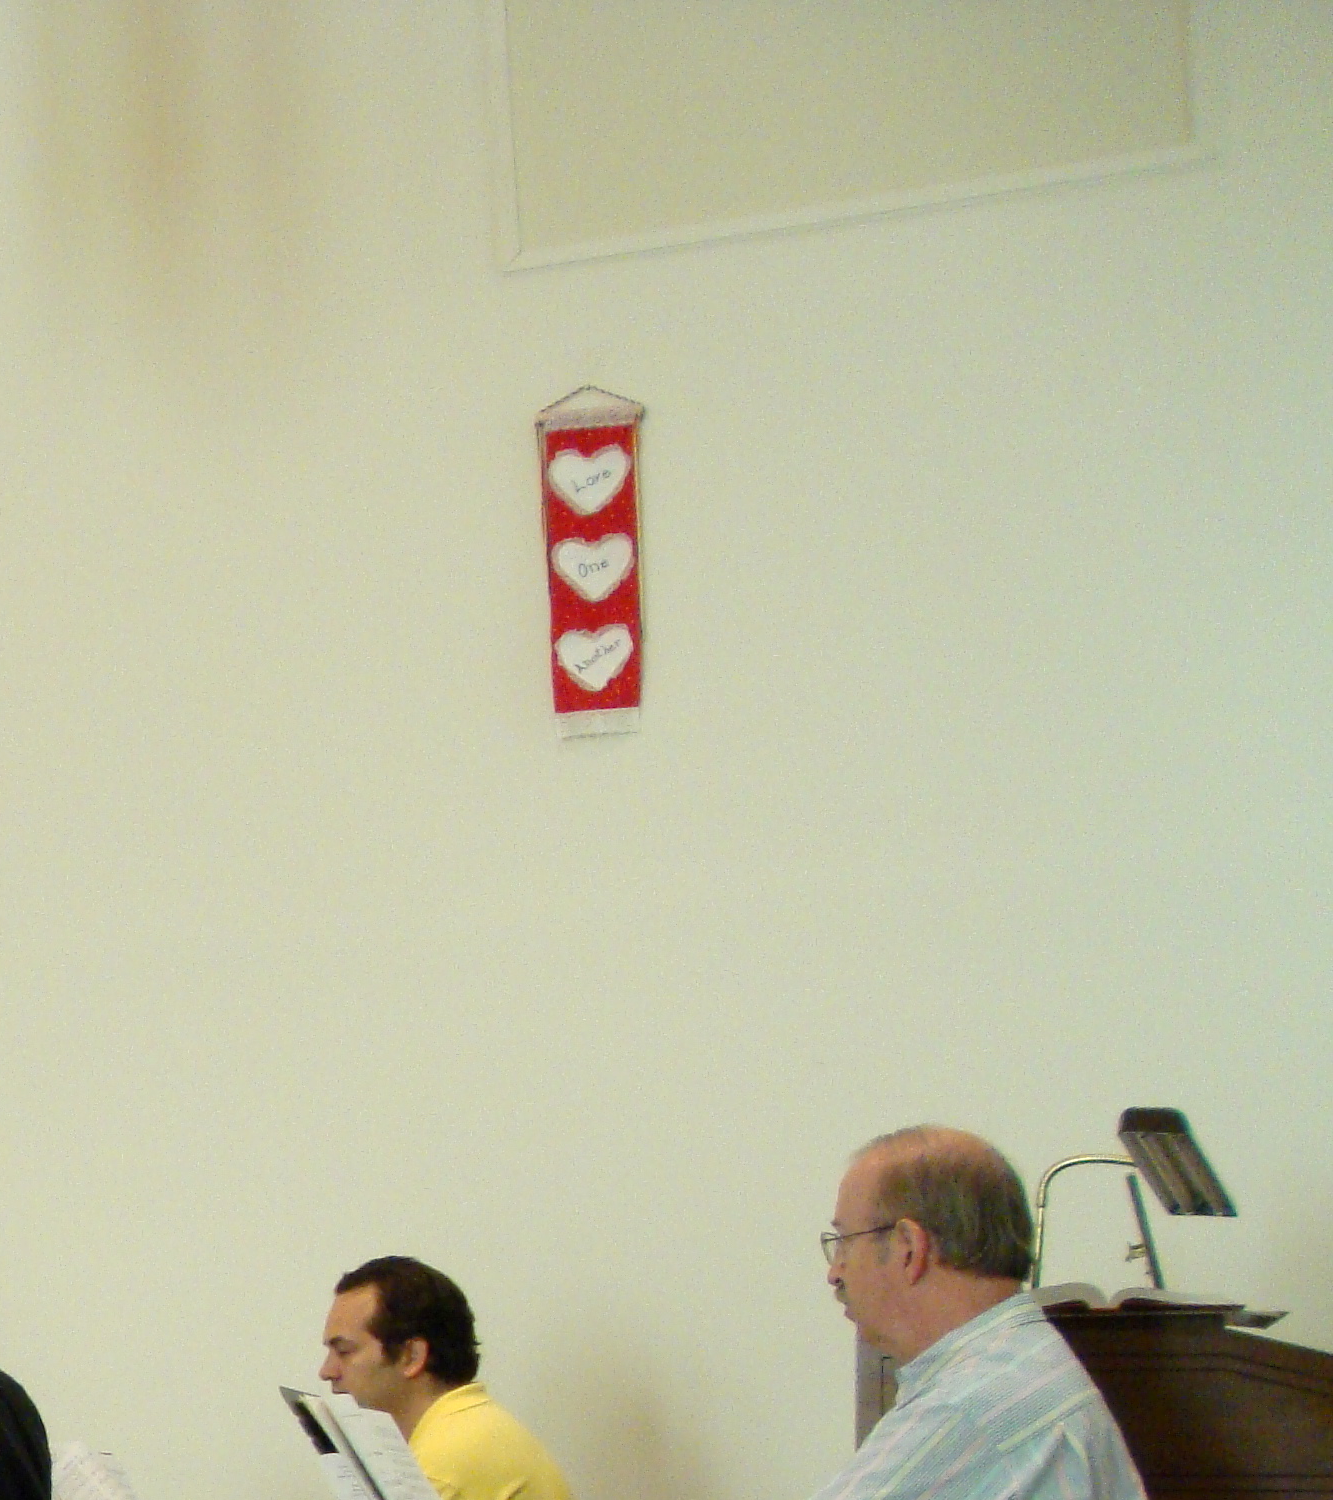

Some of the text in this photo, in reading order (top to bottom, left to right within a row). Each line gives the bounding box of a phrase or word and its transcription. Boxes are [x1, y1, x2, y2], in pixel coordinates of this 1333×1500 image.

[572, 468, 612, 493] Love
[577, 558, 610, 578] One
[574, 637, 621, 674] Another
